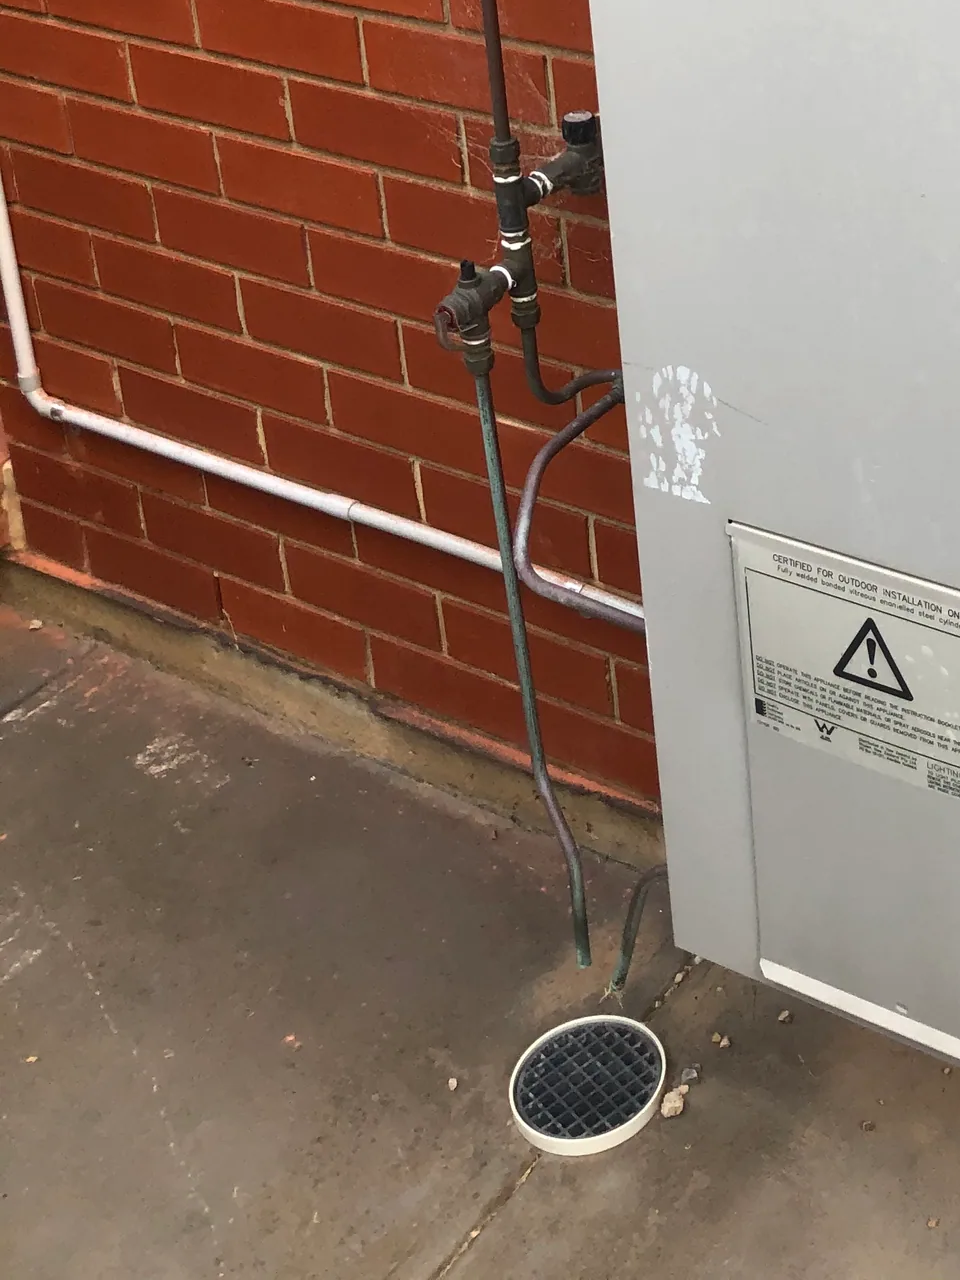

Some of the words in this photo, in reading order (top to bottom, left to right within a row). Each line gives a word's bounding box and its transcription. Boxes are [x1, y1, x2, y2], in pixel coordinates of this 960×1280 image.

[772, 553, 812, 573] CERTIFIED
[817, 567, 834, 579] FOR
[838, 574, 878, 593] OUTDOOR
[883, 588, 942, 614] INSTALLATION
[777, 565, 793, 576] Fully
[796, 572, 818, 583] welded
[821, 579, 846, 592] bonded
[849, 588, 876, 602] vitreous
[918, 611, 935, 621] steel
[776, 663, 798, 675] OPERATE
[801, 671, 811, 679] THIS
[814, 677, 840, 690] APPLIANCE
[843, 687, 861, 698] BEFORE
[865, 695, 887, 706] READING
[901, 708, 935, 722] INSTRUCTION
[795, 677, 817, 689] ARTICLES
[893, 727, 917, 740] REMOVED
[937, 742, 949, 750] THIS
